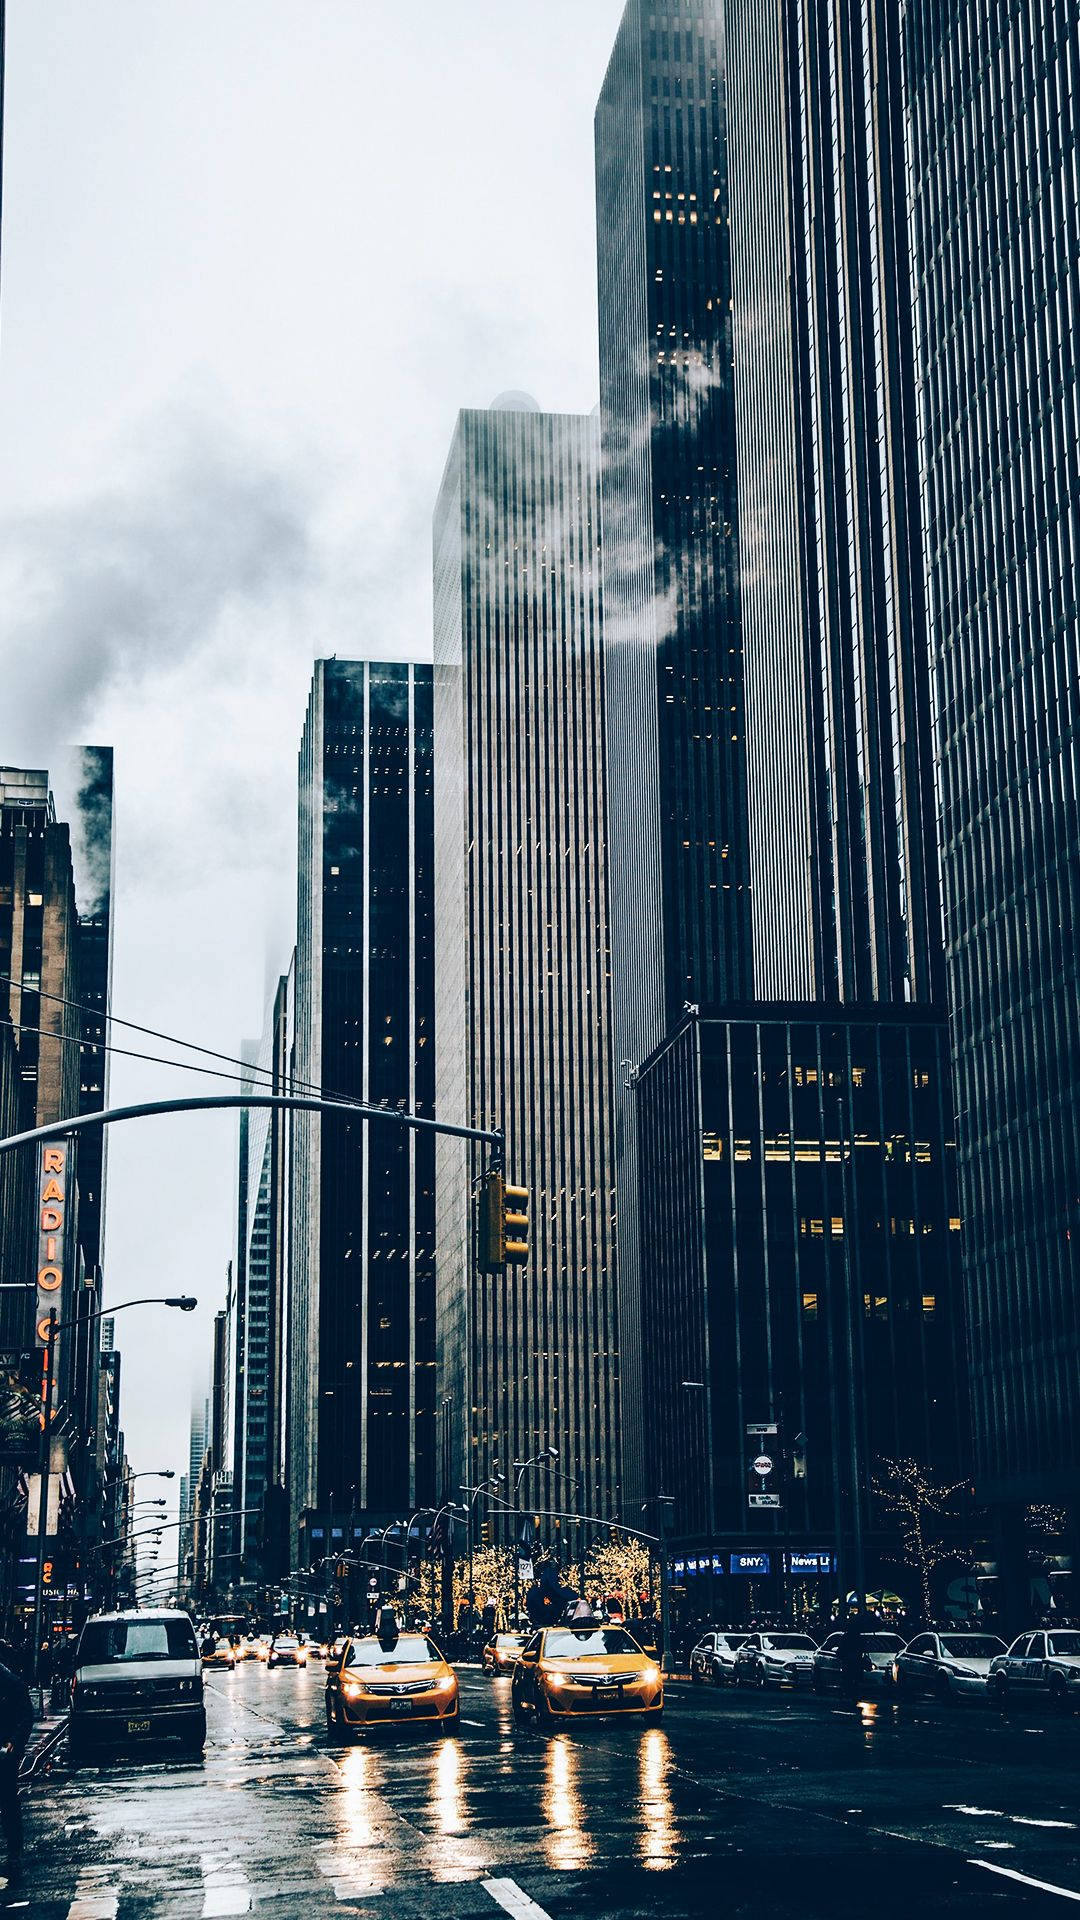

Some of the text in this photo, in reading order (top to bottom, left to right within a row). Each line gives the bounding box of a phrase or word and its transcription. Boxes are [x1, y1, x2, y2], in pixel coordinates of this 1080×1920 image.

[38, 1148, 64, 1291] RADIO
[740, 1557, 764, 1567] SNY:
[791, 1556, 818, 1566] News
